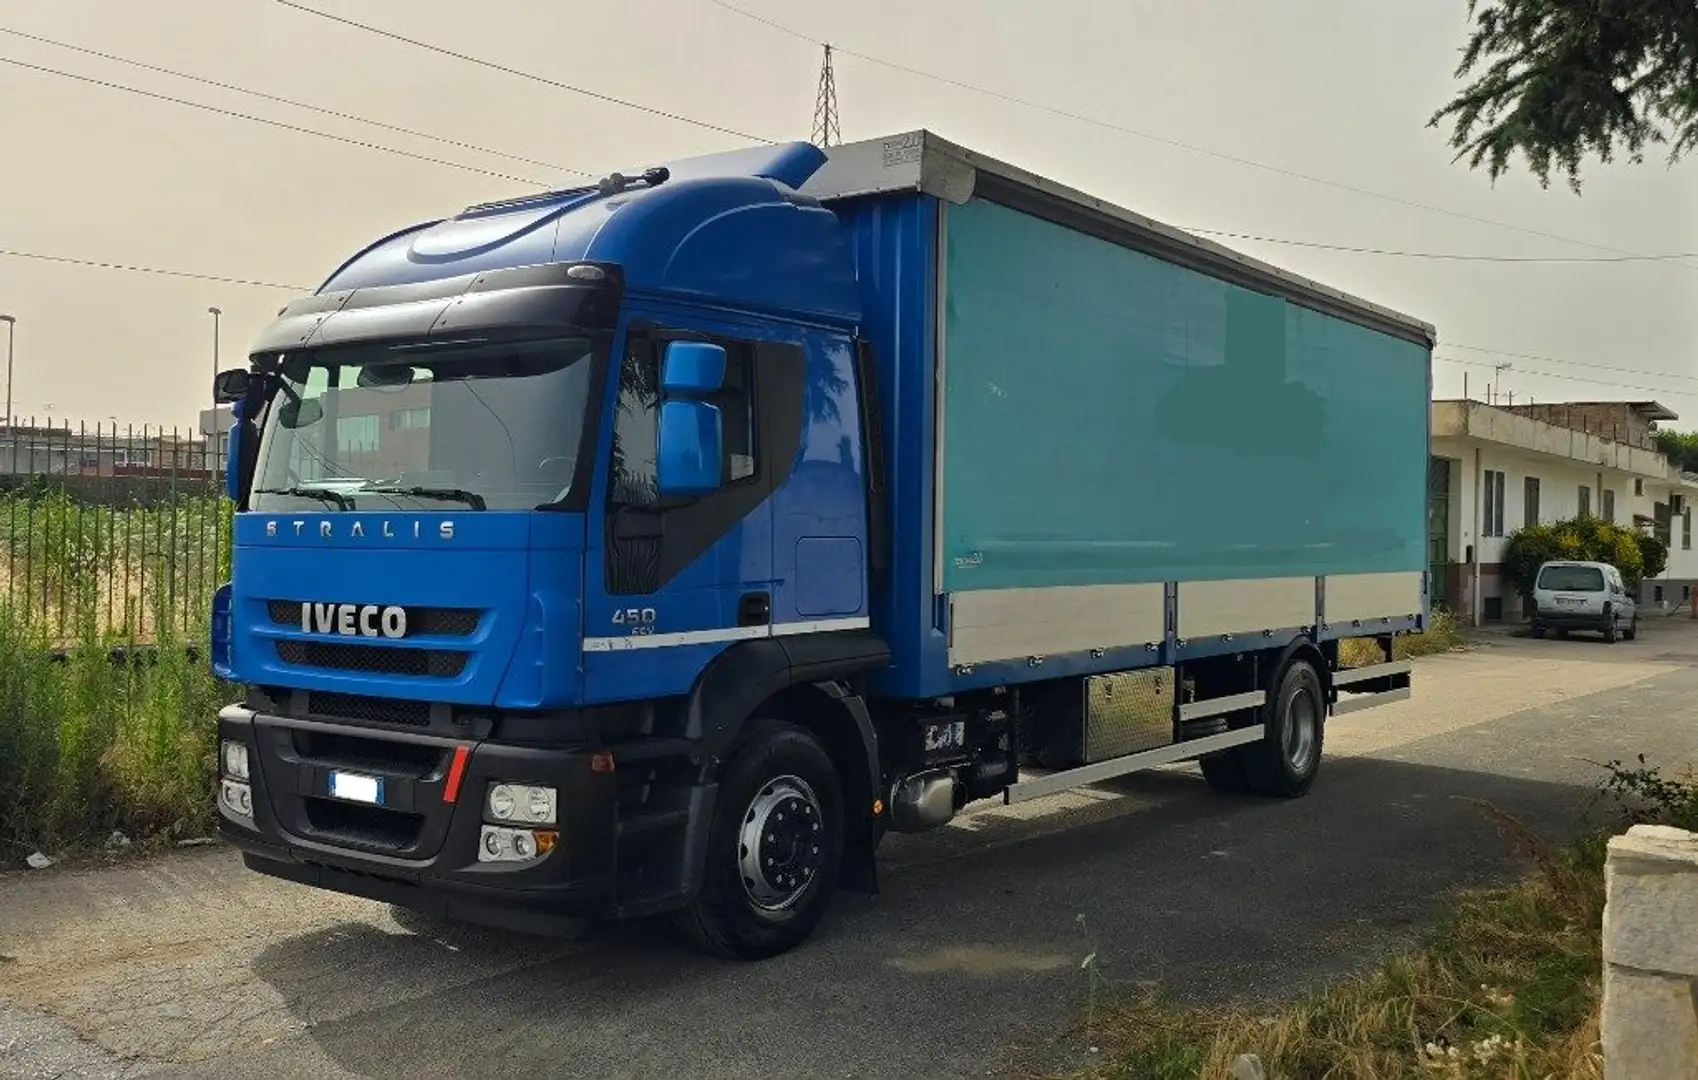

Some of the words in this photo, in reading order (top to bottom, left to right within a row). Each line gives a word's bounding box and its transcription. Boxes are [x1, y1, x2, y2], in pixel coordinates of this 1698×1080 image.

[266, 520, 455, 540] STRALIS
[301, 602, 408, 639] IVECO
[611, 607, 657, 625] 450
